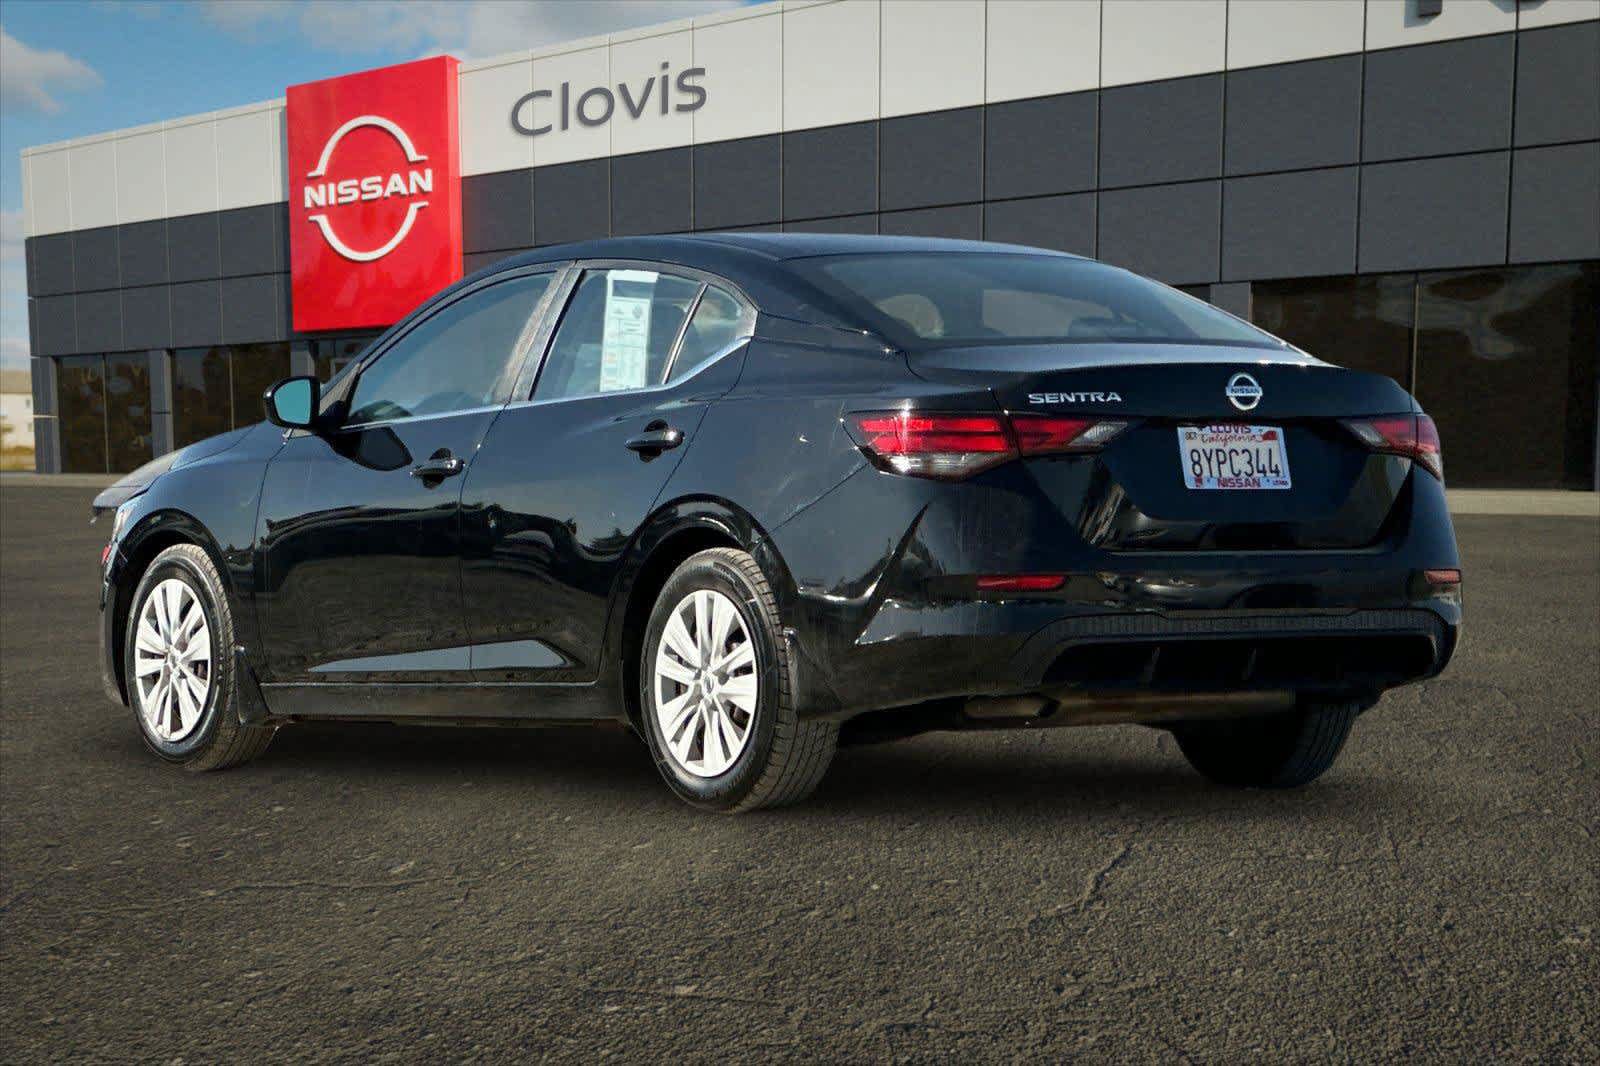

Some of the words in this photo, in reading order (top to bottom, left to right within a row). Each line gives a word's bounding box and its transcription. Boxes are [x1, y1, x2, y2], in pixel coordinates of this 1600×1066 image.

[511, 61, 707, 136] Clovis
[304, 168, 433, 209] NISSAN
[1028, 391, 1122, 404] SENTRA
[1201, 433, 1257, 446] California
[1190, 449, 1279, 477] 8YPC344
[1217, 478, 1260, 487] NISSAN
